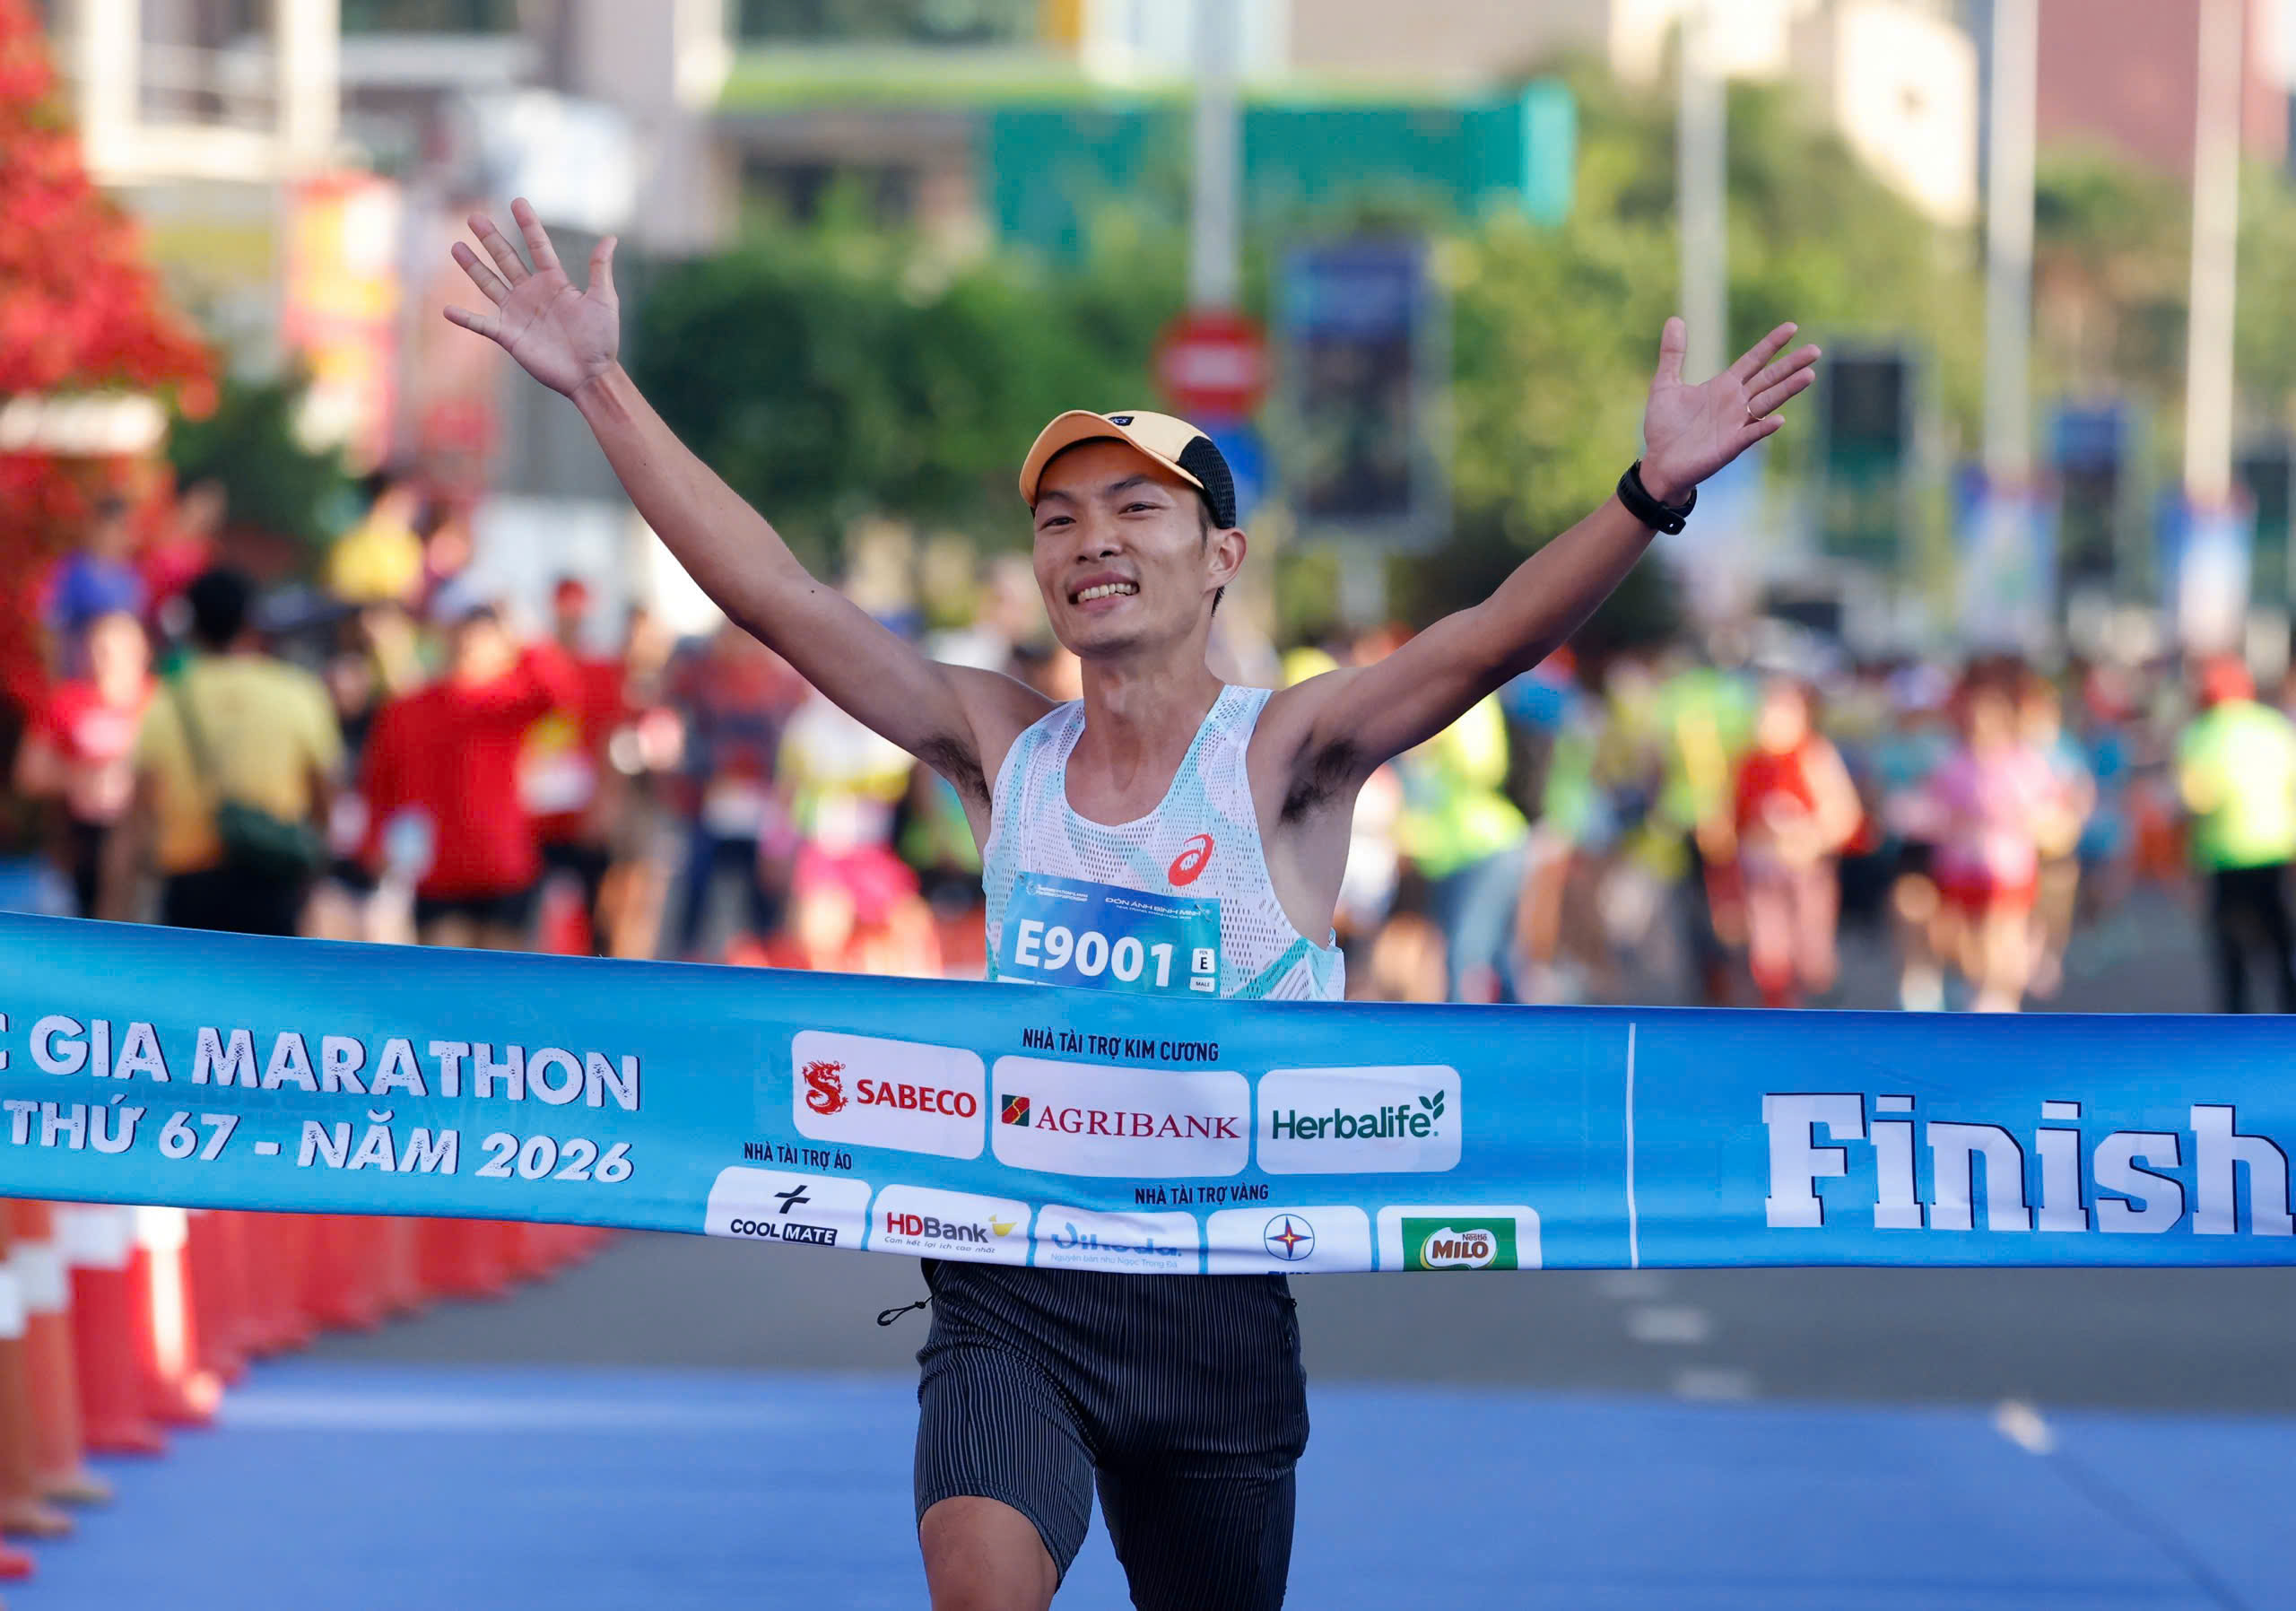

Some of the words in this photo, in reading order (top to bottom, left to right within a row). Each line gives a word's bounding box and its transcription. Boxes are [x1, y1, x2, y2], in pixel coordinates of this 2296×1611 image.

[1013, 917, 1173, 988] E9001
[1200, 956, 1208, 970] E
[1022, 1026, 1055, 1050] NHÀ
[1059, 1029, 1083, 1054] TÀI
[1088, 1034, 1122, 1060] TRỢ
[1124, 1039, 1155, 1059] KIM
[1160, 1041, 1220, 1062] CƯƠNG
[30, 1014, 170, 1082] GIA
[191, 1027, 641, 1111] MARATHON
[857, 1079, 978, 1119] SABECO
[3, 1093, 147, 1154] THỨ
[158, 1110, 241, 1162] 67
[297, 1109, 459, 1176] NĂM
[475, 1132, 636, 1184] 2026
[1036, 1105, 1240, 1139] AGRIBANK
[1273, 1104, 1431, 1140] Herbalife
[744, 1141, 774, 1163] NHÀ
[777, 1142, 798, 1165] TÀI
[802, 1148, 831, 1171] TRỢ
[833, 1148, 852, 1171] ÁO
[1761, 1092, 2296, 1236] Finish
[1135, 1184, 1167, 1205] NHÀ
[1170, 1183, 1193, 1204] TÀI
[1198, 1185, 1228, 1206] TRỢ
[1230, 1181, 1269, 1202] VÀNG
[884, 1236, 903, 1245] Cam
[886, 1212, 989, 1244] HDBank
[1432, 1240, 1489, 1259] MILO
